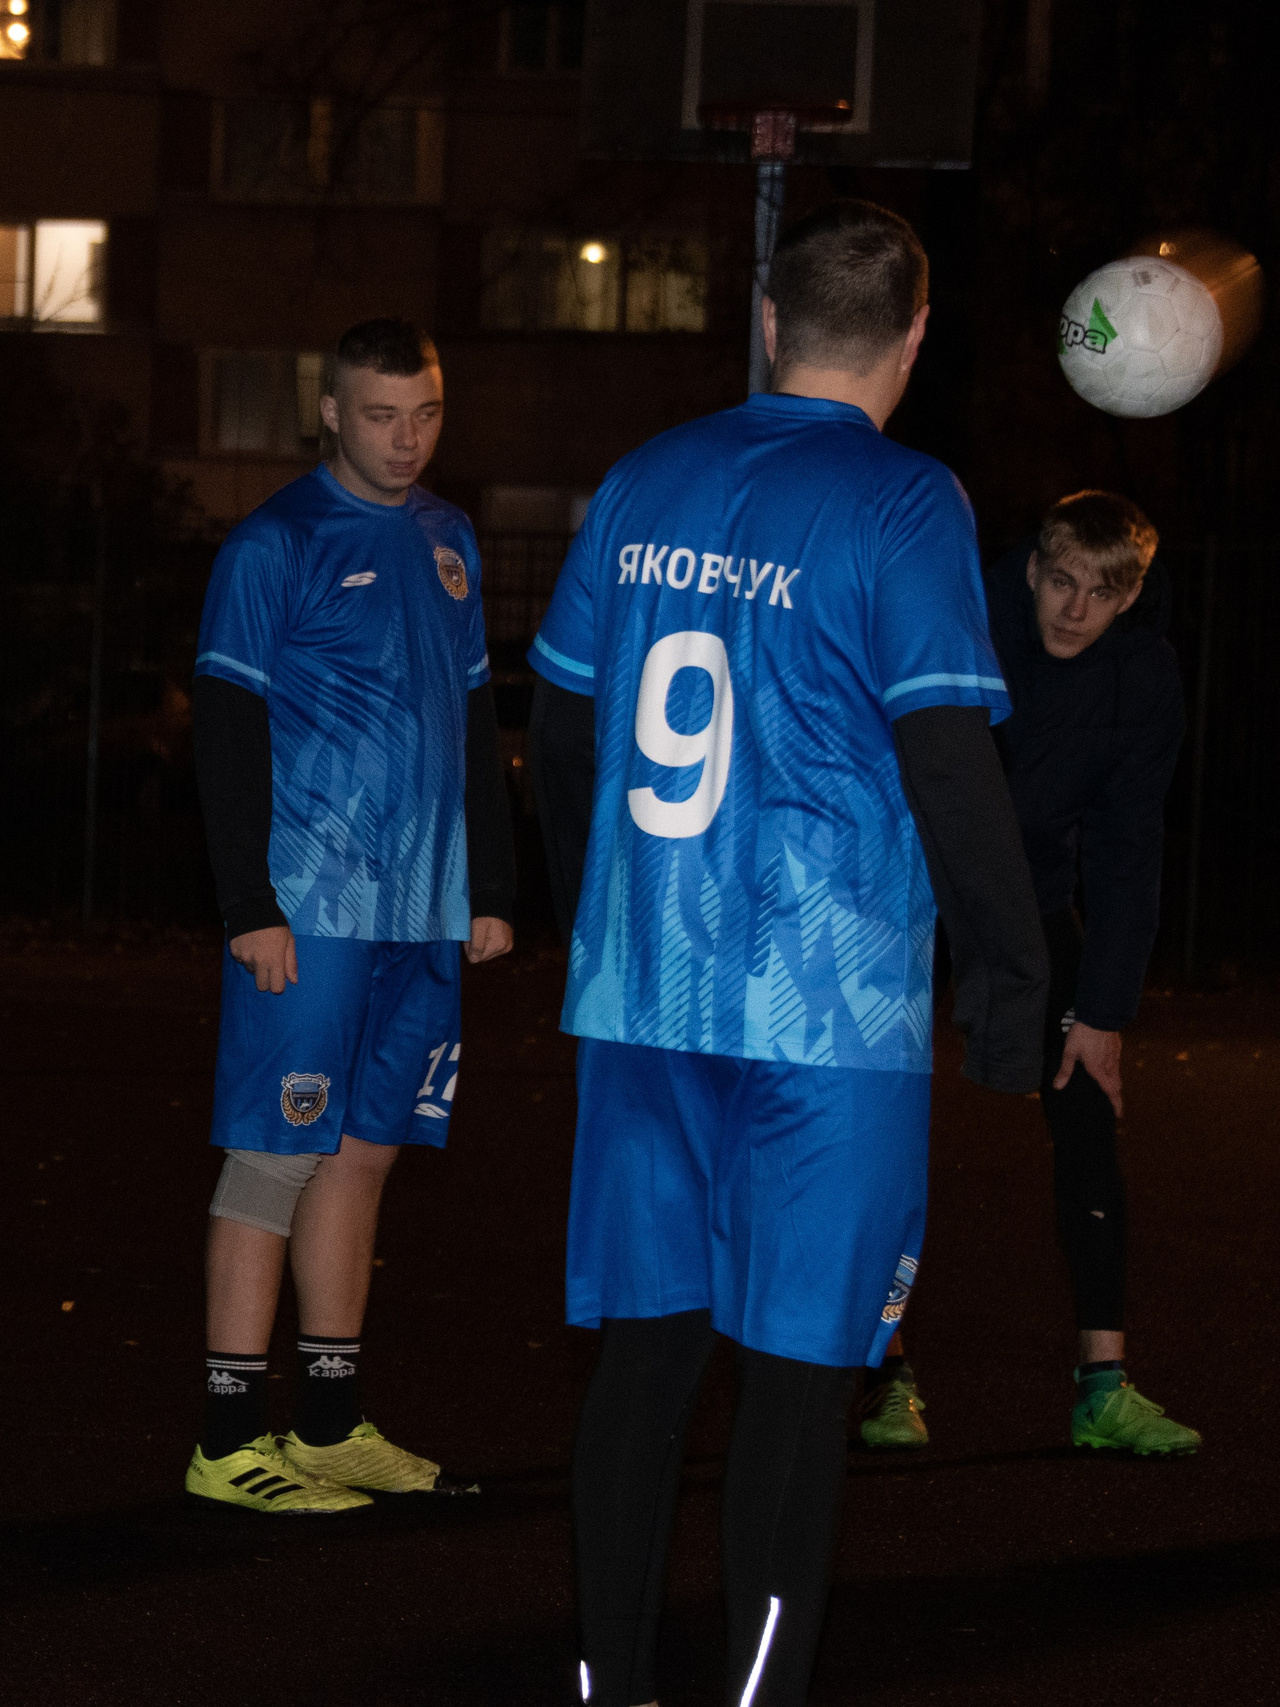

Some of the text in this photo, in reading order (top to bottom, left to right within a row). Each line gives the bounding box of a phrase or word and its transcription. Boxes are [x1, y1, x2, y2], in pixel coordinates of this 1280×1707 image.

[618, 543, 800, 609] ЯКОВЧУК
[627, 630, 734, 839] 9
[309, 1366, 356, 1379] Kappa
